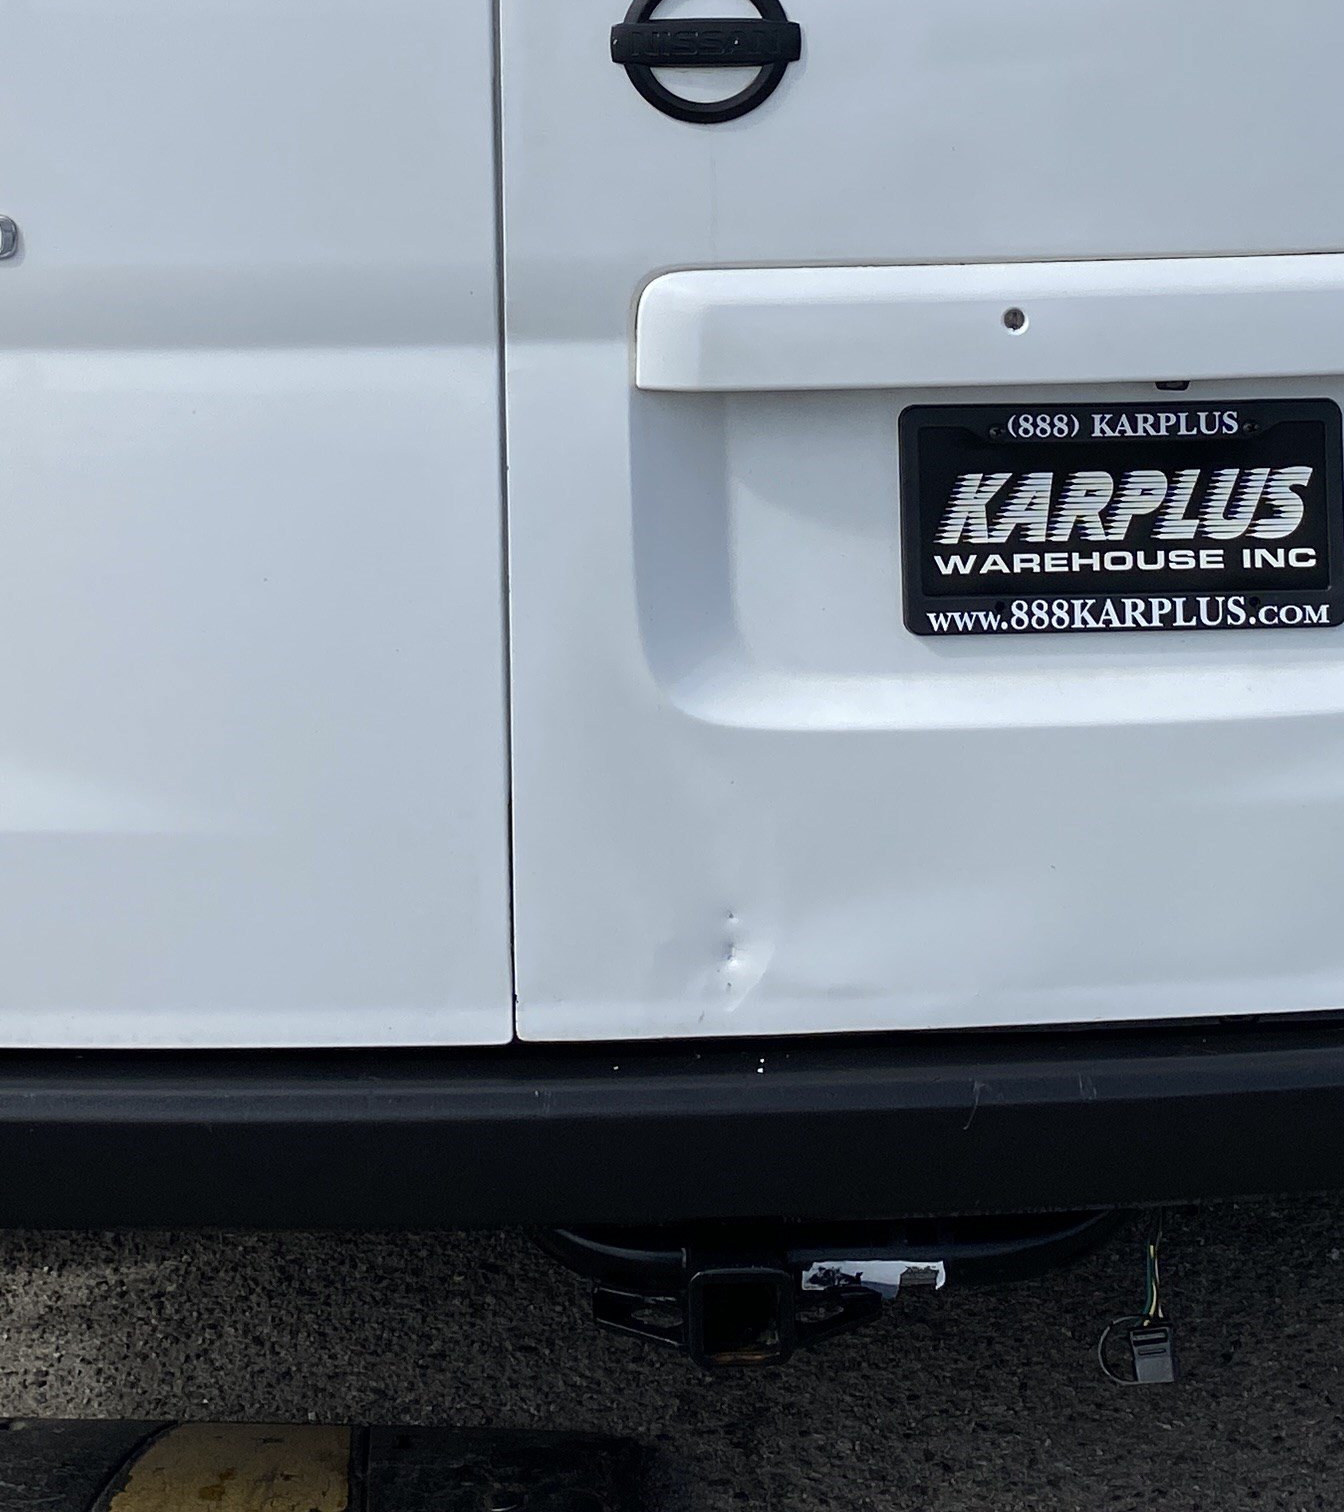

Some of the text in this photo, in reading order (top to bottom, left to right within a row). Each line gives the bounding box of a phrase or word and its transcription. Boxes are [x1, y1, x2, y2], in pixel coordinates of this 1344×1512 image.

[1006, 411, 1239, 438] (888) KARPLUS
[932, 466, 1314, 544] KARPLUS
[933, 547, 1318, 575] WAREHOUSE INC
